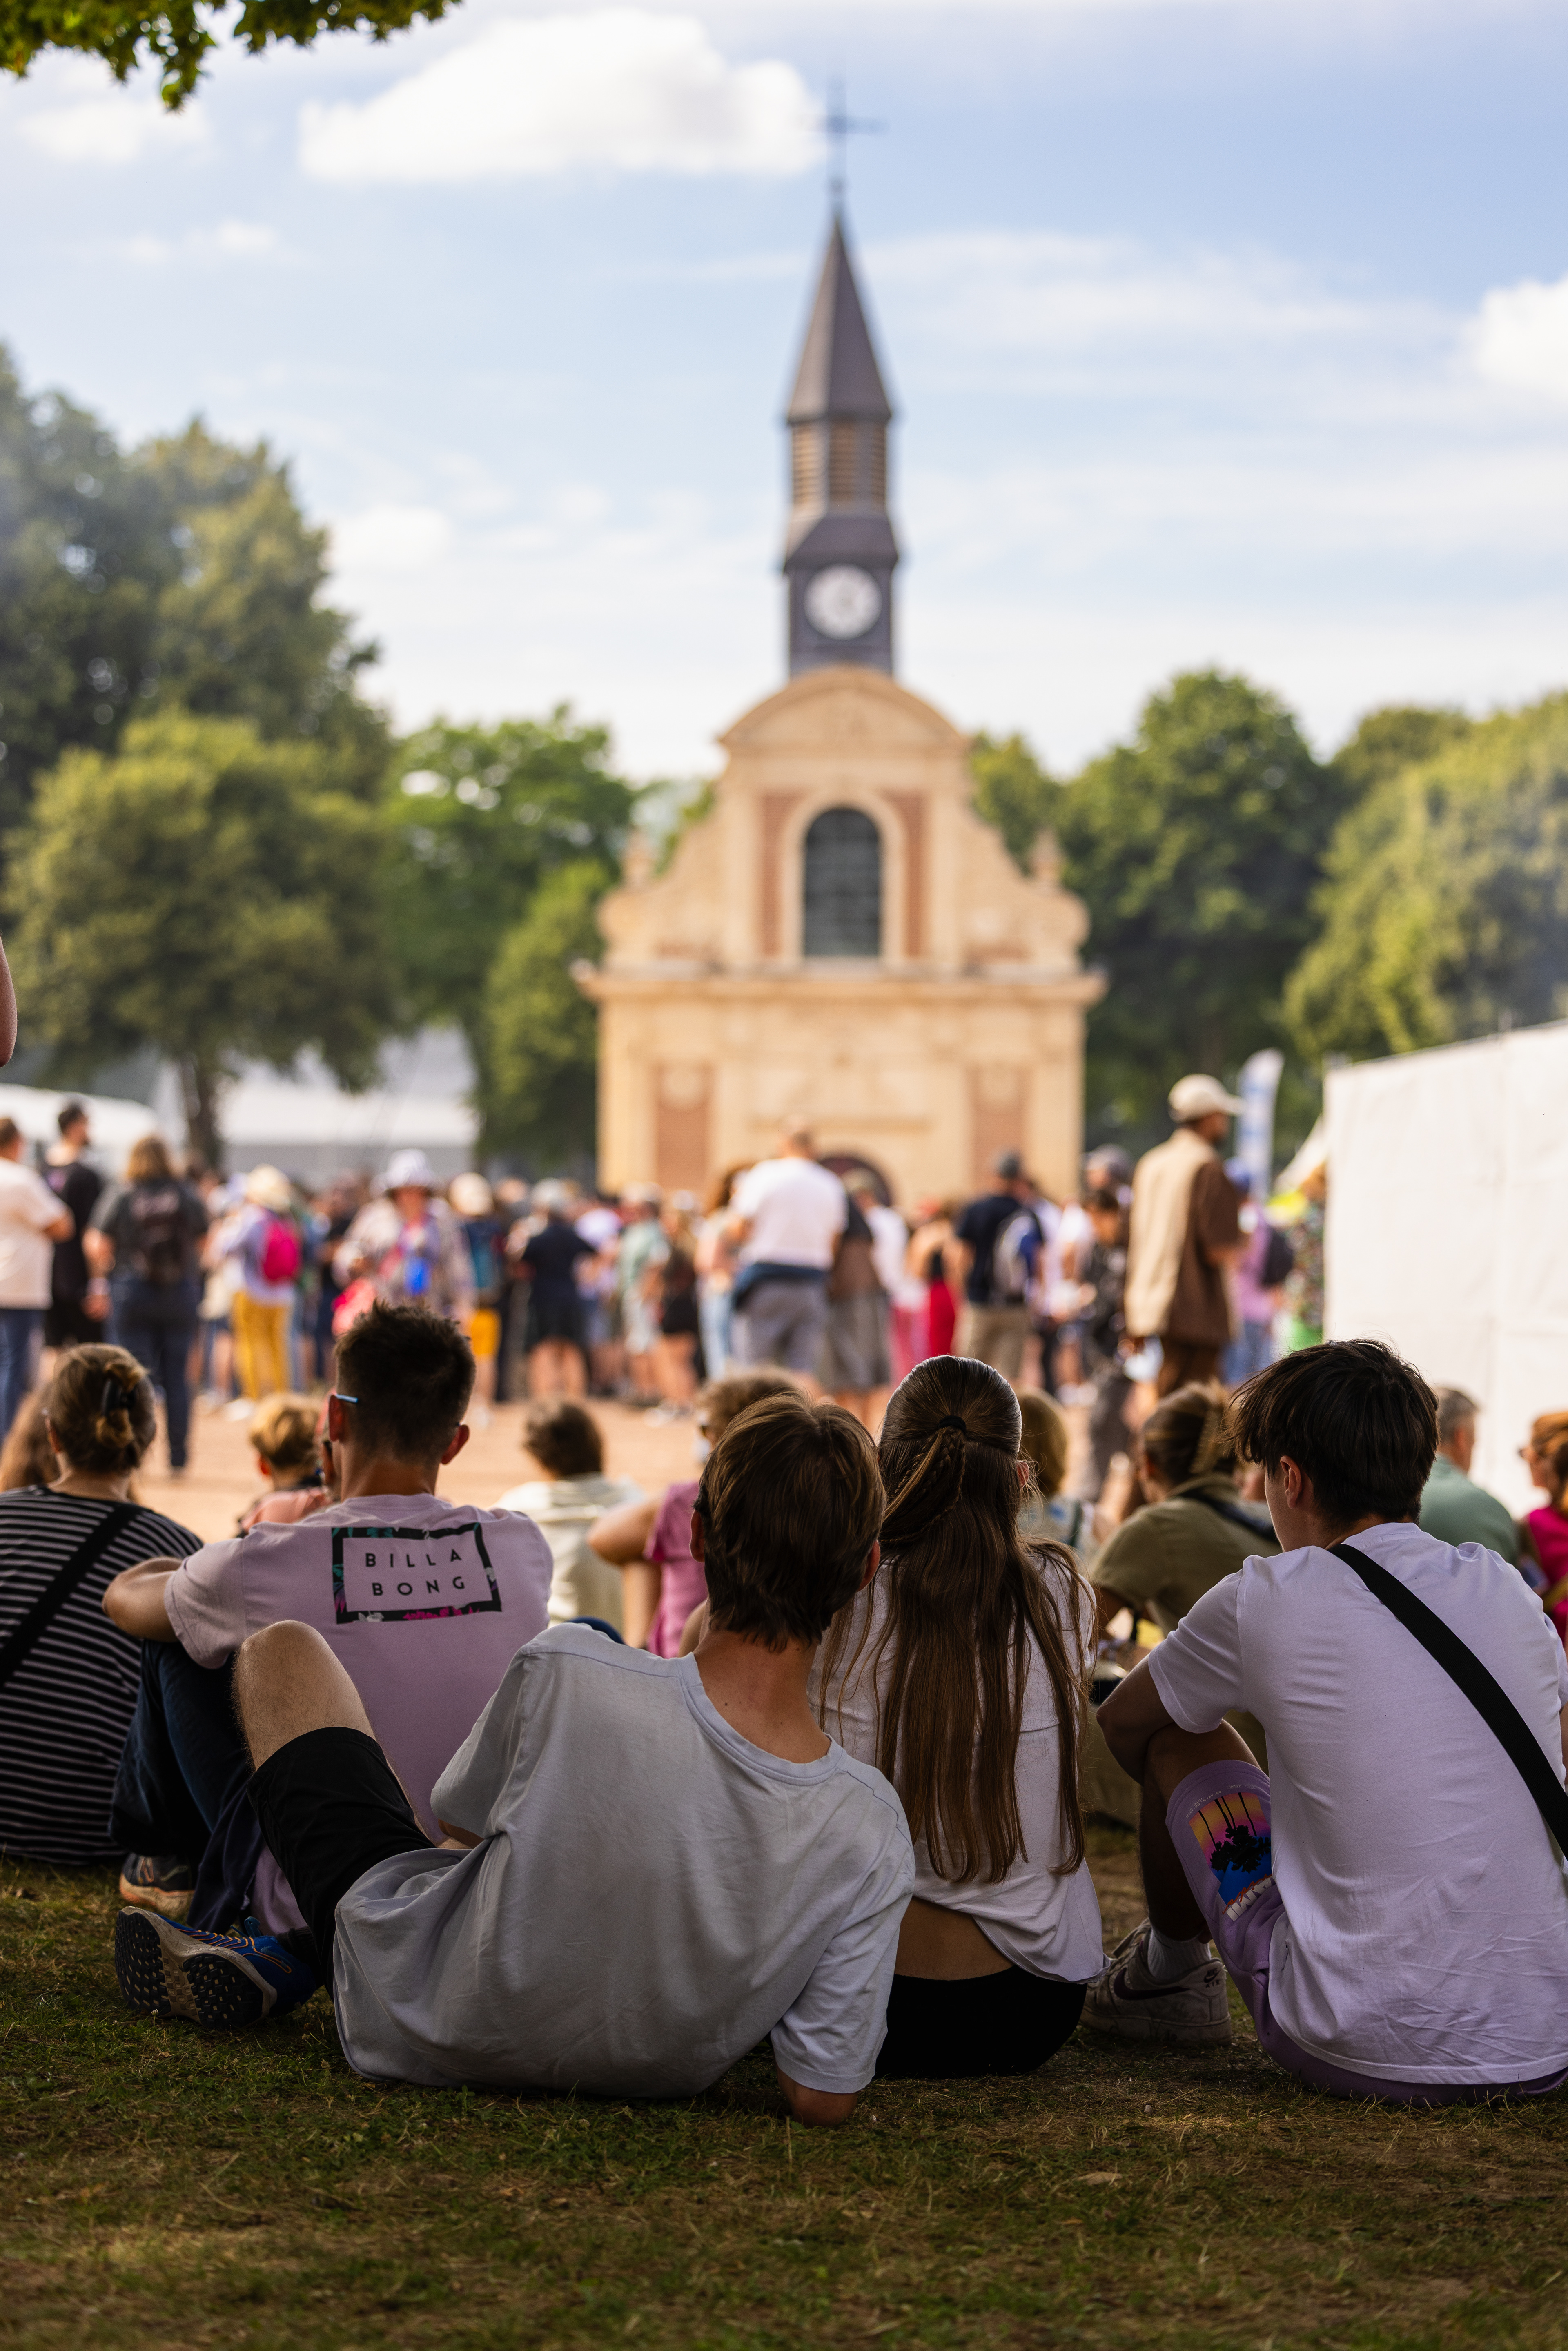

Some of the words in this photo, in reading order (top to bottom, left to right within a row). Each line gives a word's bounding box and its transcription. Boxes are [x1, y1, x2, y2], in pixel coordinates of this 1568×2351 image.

[365, 1549, 462, 1567] BILLA
[372, 1576, 465, 1596] BONG
[1205, 1979, 1220, 1988] AIR
